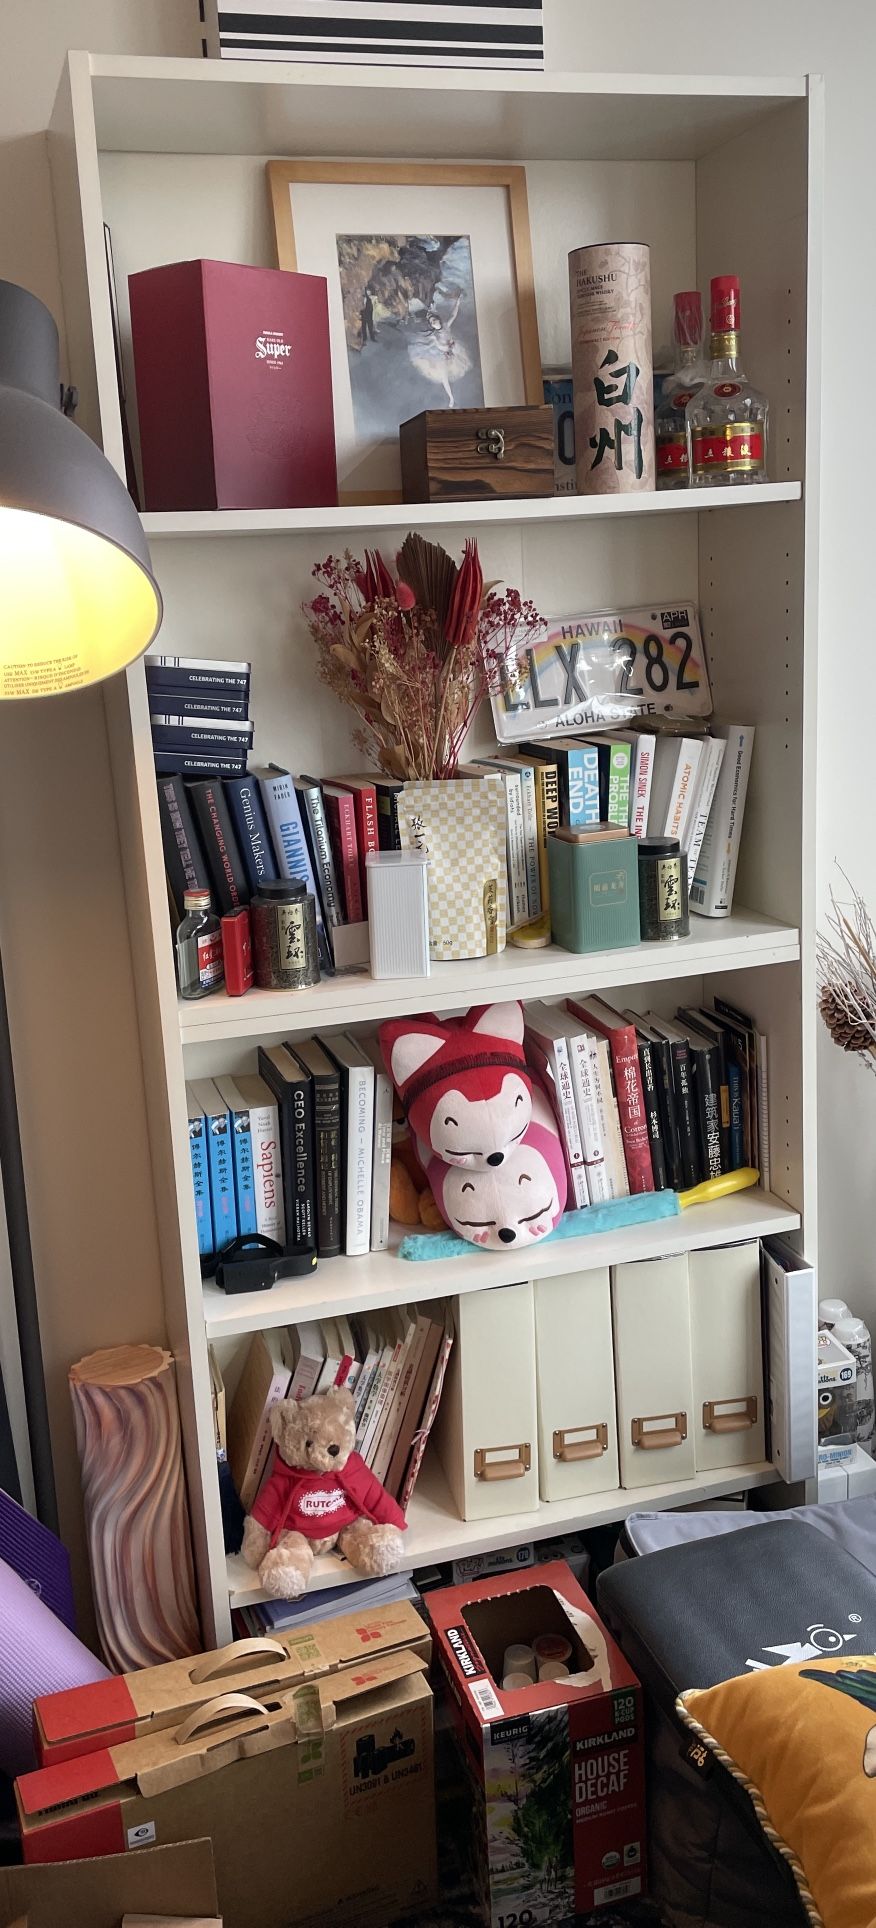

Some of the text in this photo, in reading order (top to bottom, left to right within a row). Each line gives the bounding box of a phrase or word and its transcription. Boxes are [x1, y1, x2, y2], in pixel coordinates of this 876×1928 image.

[255, 336, 292, 359] Super
[589, 350, 644, 479] 白州
[561, 619, 624, 640] HAWAII
[189, 675, 225, 684] CELEBRATING
[225, 677, 236, 685] THE
[609, 631, 700, 697] 282
[184, 703, 220, 712] CELEBRATING
[555, 711, 606, 728] ALOHA
[191, 733, 226, 741] CELEBRATING
[184, 760, 219, 769] CELEBRATING
[640, 752, 650, 776] SIMON
[206, 789, 215, 804] THE
[545, 770, 557, 804] DEEP
[568, 767, 584, 814] END
[583, 752, 600, 825] DEATH
[620, 774, 629, 802] THE
[637, 777, 647, 799] SINEK
[731, 763, 743, 798] Economics
[635, 805, 645, 823] THE
[670, 763, 692, 836] ATOMIC HABITS
[728, 806, 738, 823] Hard
[730, 797, 738, 807] for
[209, 806, 227, 853] CHANGING
[240, 788, 267, 877] Genius Makers
[365, 797, 375, 836] FLASH
[693, 814, 708, 848] TEAM
[727, 823, 736, 839] Times
[279, 821, 310, 883] GIANNIS
[311, 795, 336, 908] The Titanium Economy
[221, 854, 234, 883] WORLD
[560, 1062, 572, 1100] 全球通史
[579, 1058, 592, 1098] 全球通史
[624, 1066, 642, 1120] 棉花帝国
[679, 1063, 689, 1095] 百年孤独
[294, 1090, 307, 1193] CEO Excellence
[356, 1080, 367, 1236] BECOMING MICHELLE OBAMA
[257, 1140, 277, 1209] Sapiens
[841, 1370, 852, 1380] 169
[447, 1629, 477, 1676] KIRKLAND
[614, 1697, 634, 1710] 120
[494, 1725, 528, 1740] KEURIG
[576, 1728, 635, 1751] KIRKLAND
[574, 1750, 629, 1783] HOUSE
[575, 1770, 628, 1803] DECAF
[576, 1801, 608, 1817] ORGANIC
[498, 1909, 533, 1928] 120
